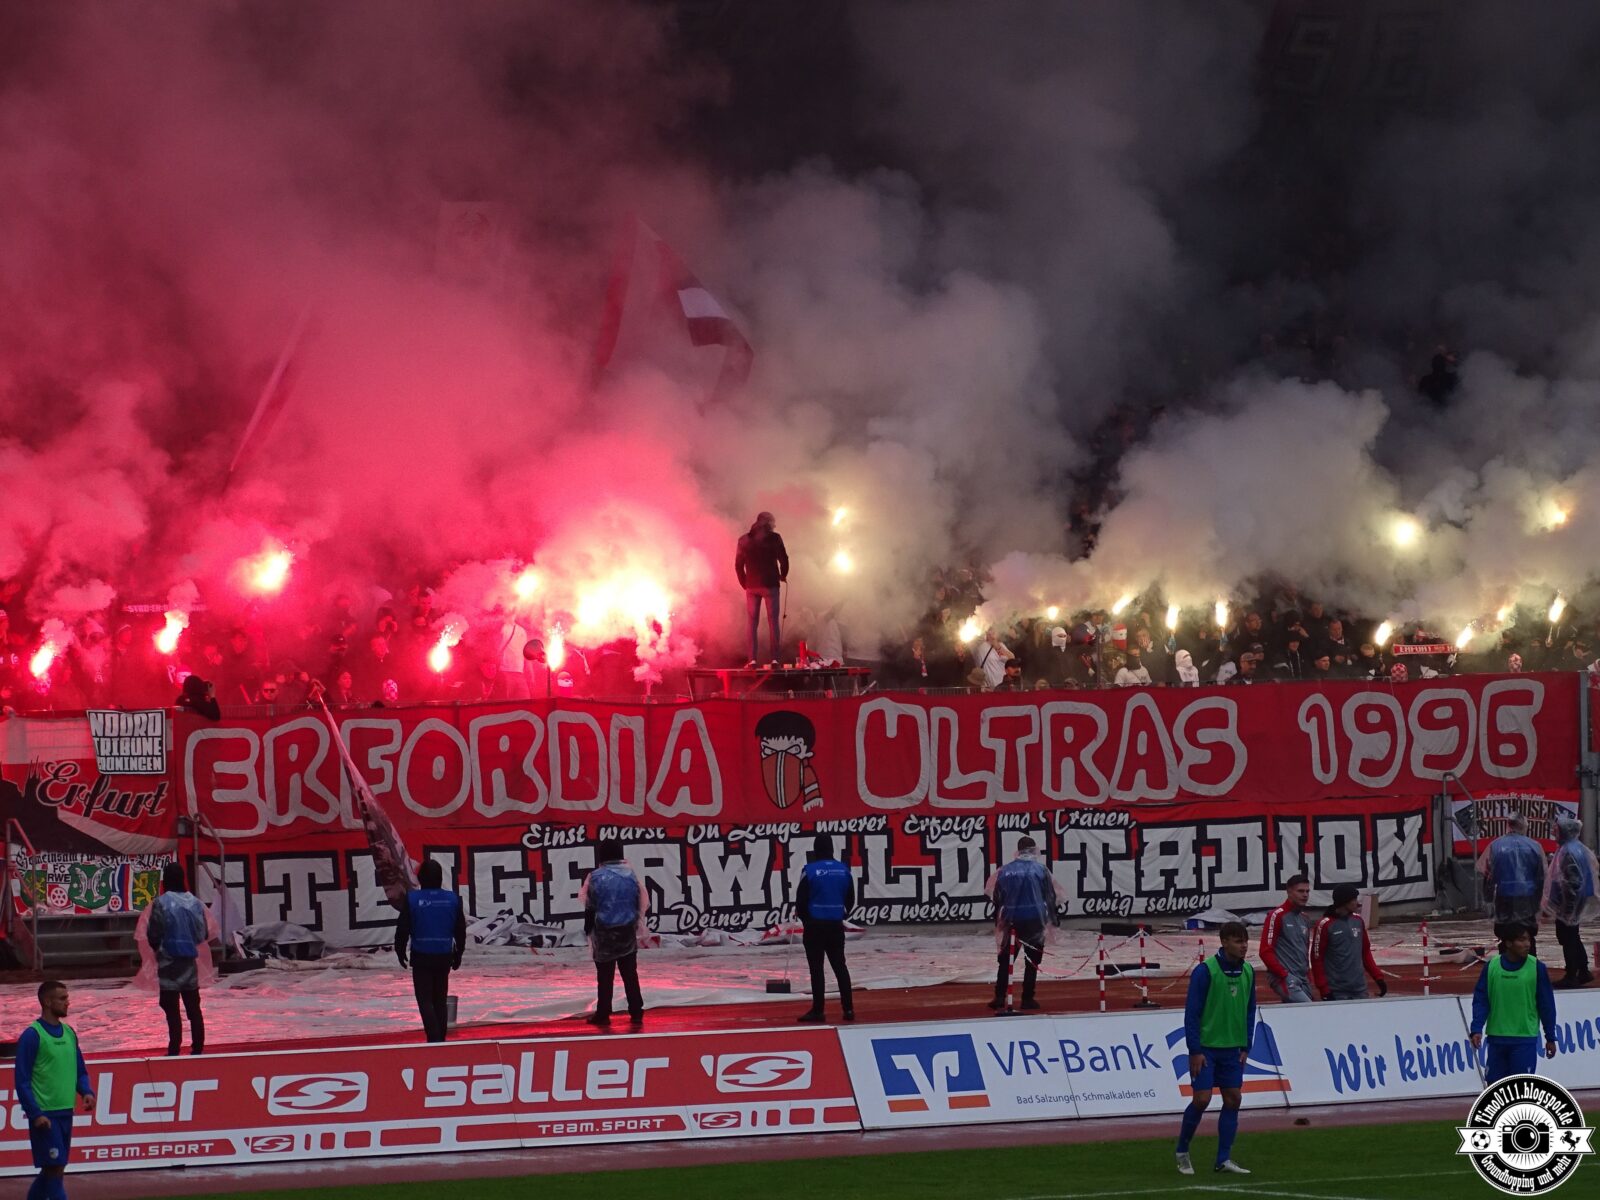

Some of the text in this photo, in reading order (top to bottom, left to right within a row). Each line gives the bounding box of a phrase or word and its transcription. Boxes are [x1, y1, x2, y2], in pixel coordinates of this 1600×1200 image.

[93, 737, 162, 756] TRIBUNE
[184, 678, 1545, 838] ERFORDIA ULTRAS 1996
[36, 761, 169, 819] Erfurt
[522, 823, 586, 849] Einst
[687, 822, 720, 845] Du
[816, 812, 887, 833] unserer
[904, 813, 986, 844] Erfolge
[47, 873, 71, 883] RWE
[53, 864, 66, 874] FC
[669, 903, 752, 931] Deiner
[902, 893, 972, 920] werden
[1085, 894, 1131, 917] ewig
[1147, 887, 1212, 911] sehnen
[987, 1033, 1162, 1077] VR-Bank
[1325, 1041, 1387, 1094] Wir
[1016, 1088, 1157, 1106] Bad Salzungen Schmalkalden eG
